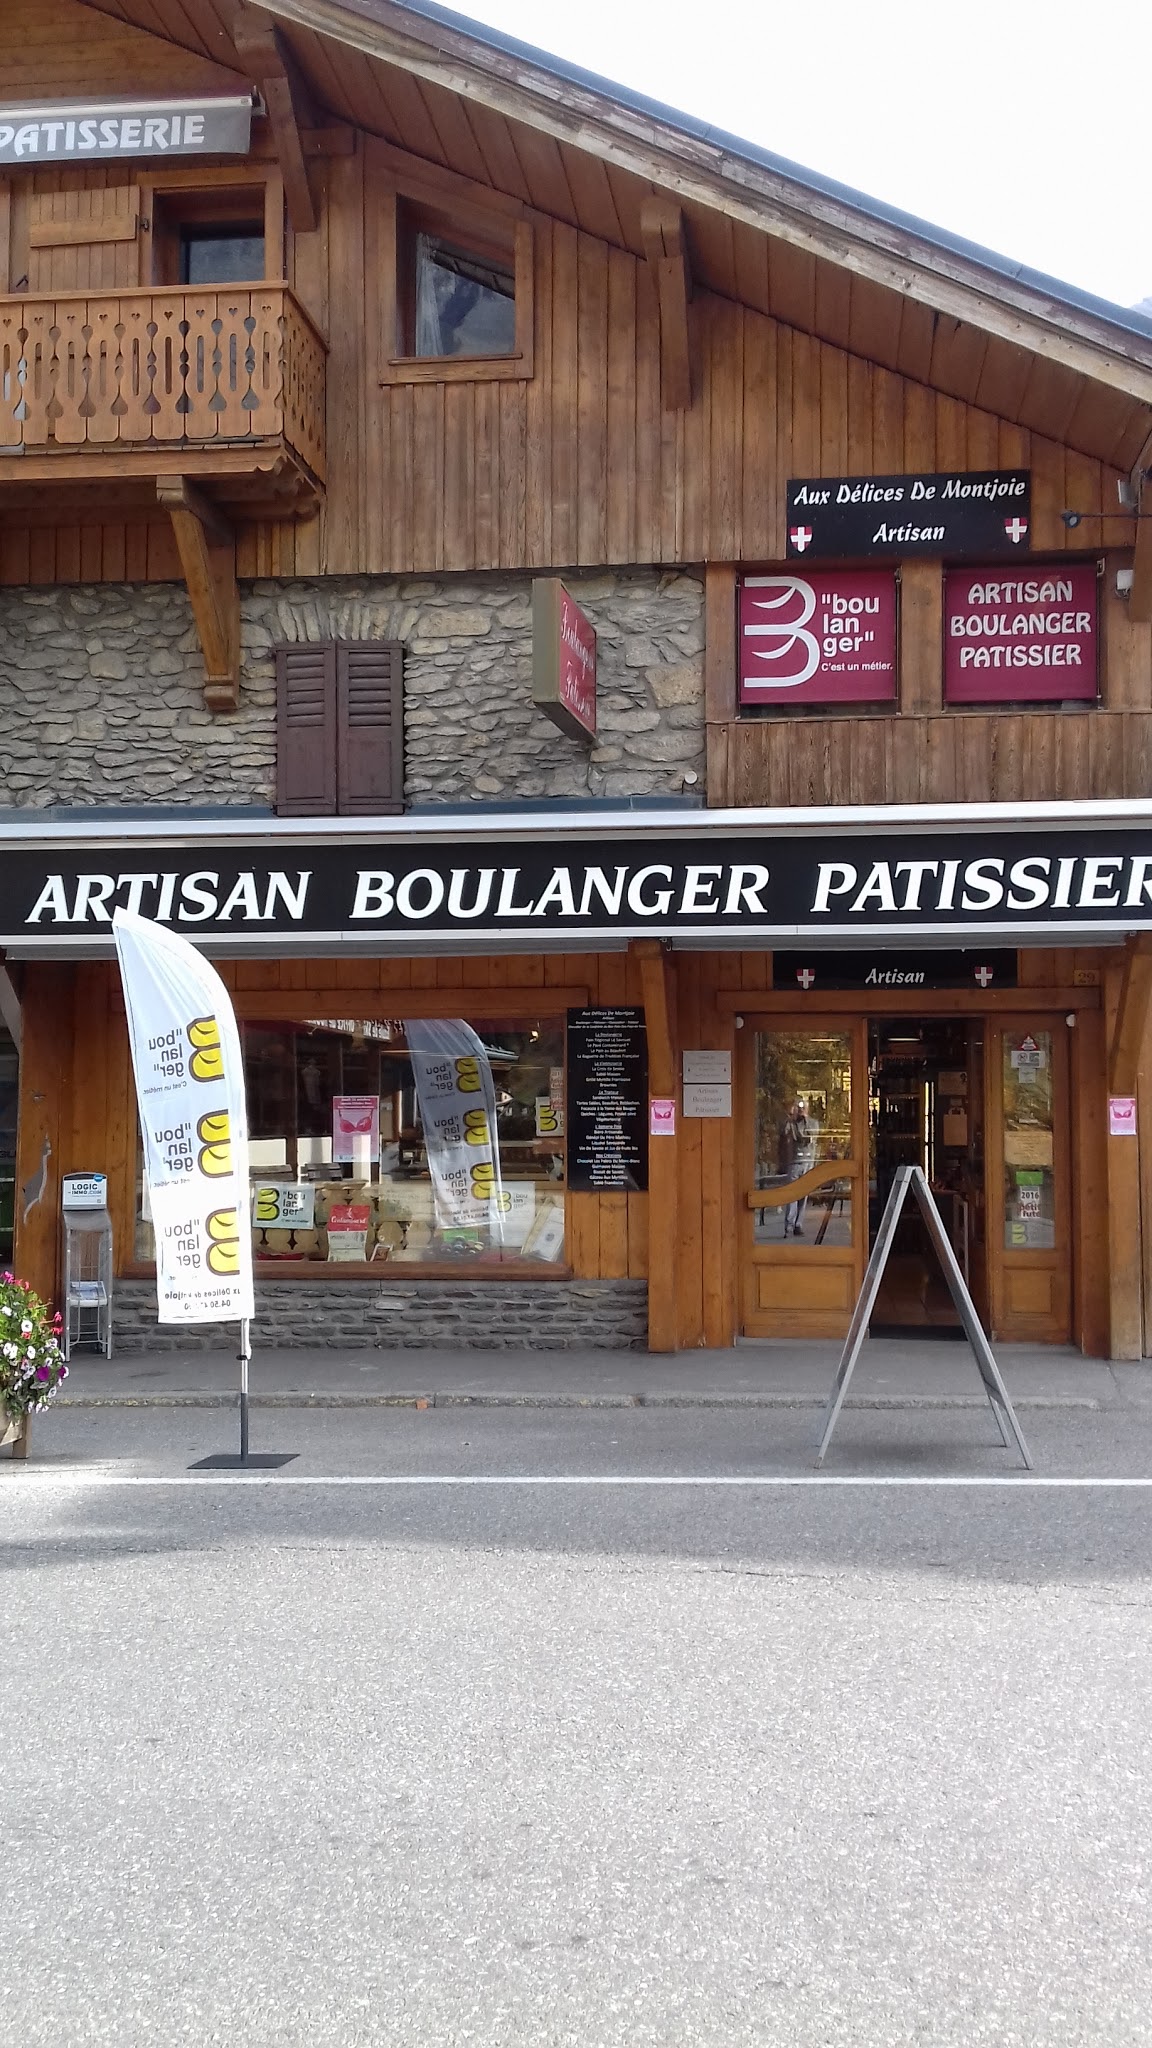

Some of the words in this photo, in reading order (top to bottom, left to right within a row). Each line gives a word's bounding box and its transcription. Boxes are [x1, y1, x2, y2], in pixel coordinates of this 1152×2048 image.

[793, 485, 831, 507] Aux
[836, 481, 904, 504] Délices
[910, 480, 936, 500] De
[941, 477, 1026, 502] Montjoie
[872, 523, 946, 543] Artisan
[967, 580, 1073, 604] ARTISAN
[823, 613, 860, 634] lan
[950, 611, 1092, 637] BOULANGER
[821, 663, 845, 671] C'est
[861, 661, 893, 671] métier.
[959, 644, 1082, 668] PATISSIER
[24, 871, 312, 924] ARTISAN
[349, 864, 771, 919] BOULANGER
[865, 968, 925, 984] Artisan
